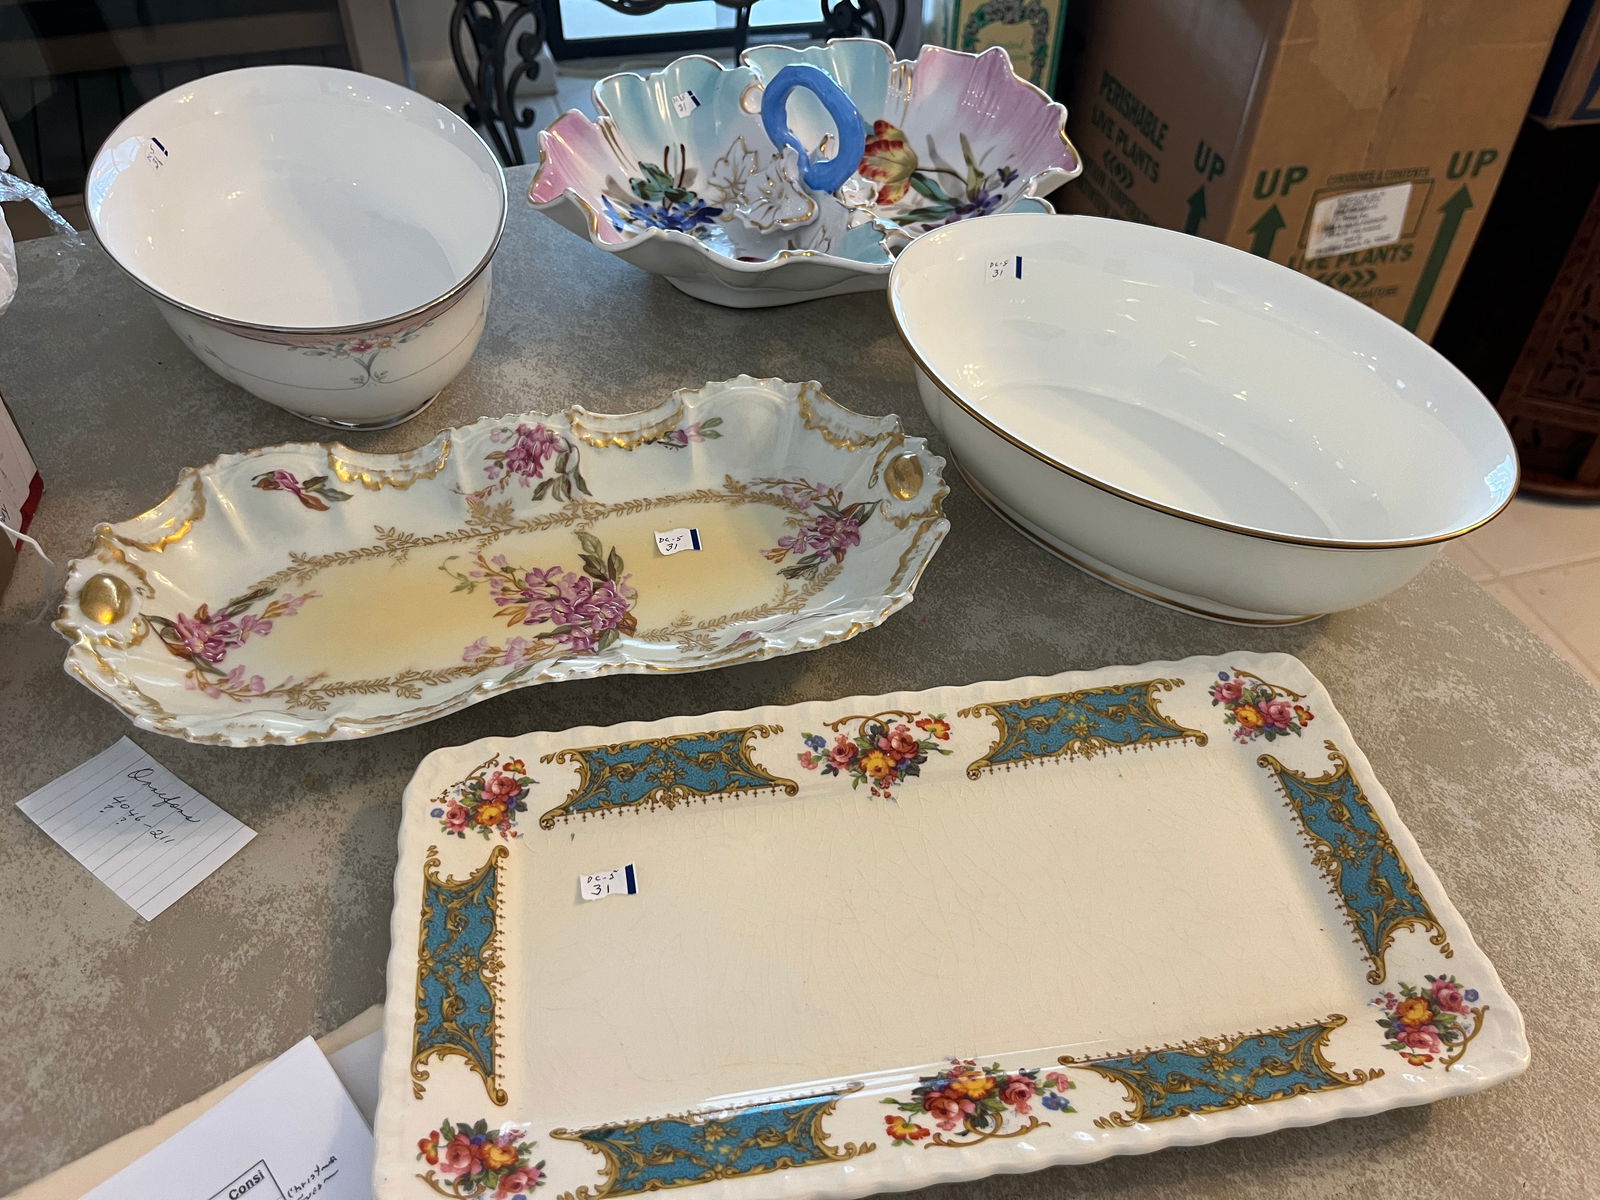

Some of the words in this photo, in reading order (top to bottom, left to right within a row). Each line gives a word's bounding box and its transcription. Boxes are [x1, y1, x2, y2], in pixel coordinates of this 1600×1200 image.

[1100, 71, 1168, 151] PERISHABLE
[1092, 106, 1116, 140] LIVE
[1115, 127, 1160, 184] PLANTS
[1194, 140, 1225, 182] UP
[1447, 149, 1500, 180] UP
[1254, 165, 1308, 200] UP
[1336, 244, 1414, 268] PLANTS
[992, 269, 1003, 278] 31
[665, 543, 678, 552] 31
[591, 884, 610, 896] 31
[228, 1169, 265, 1200] Consi
